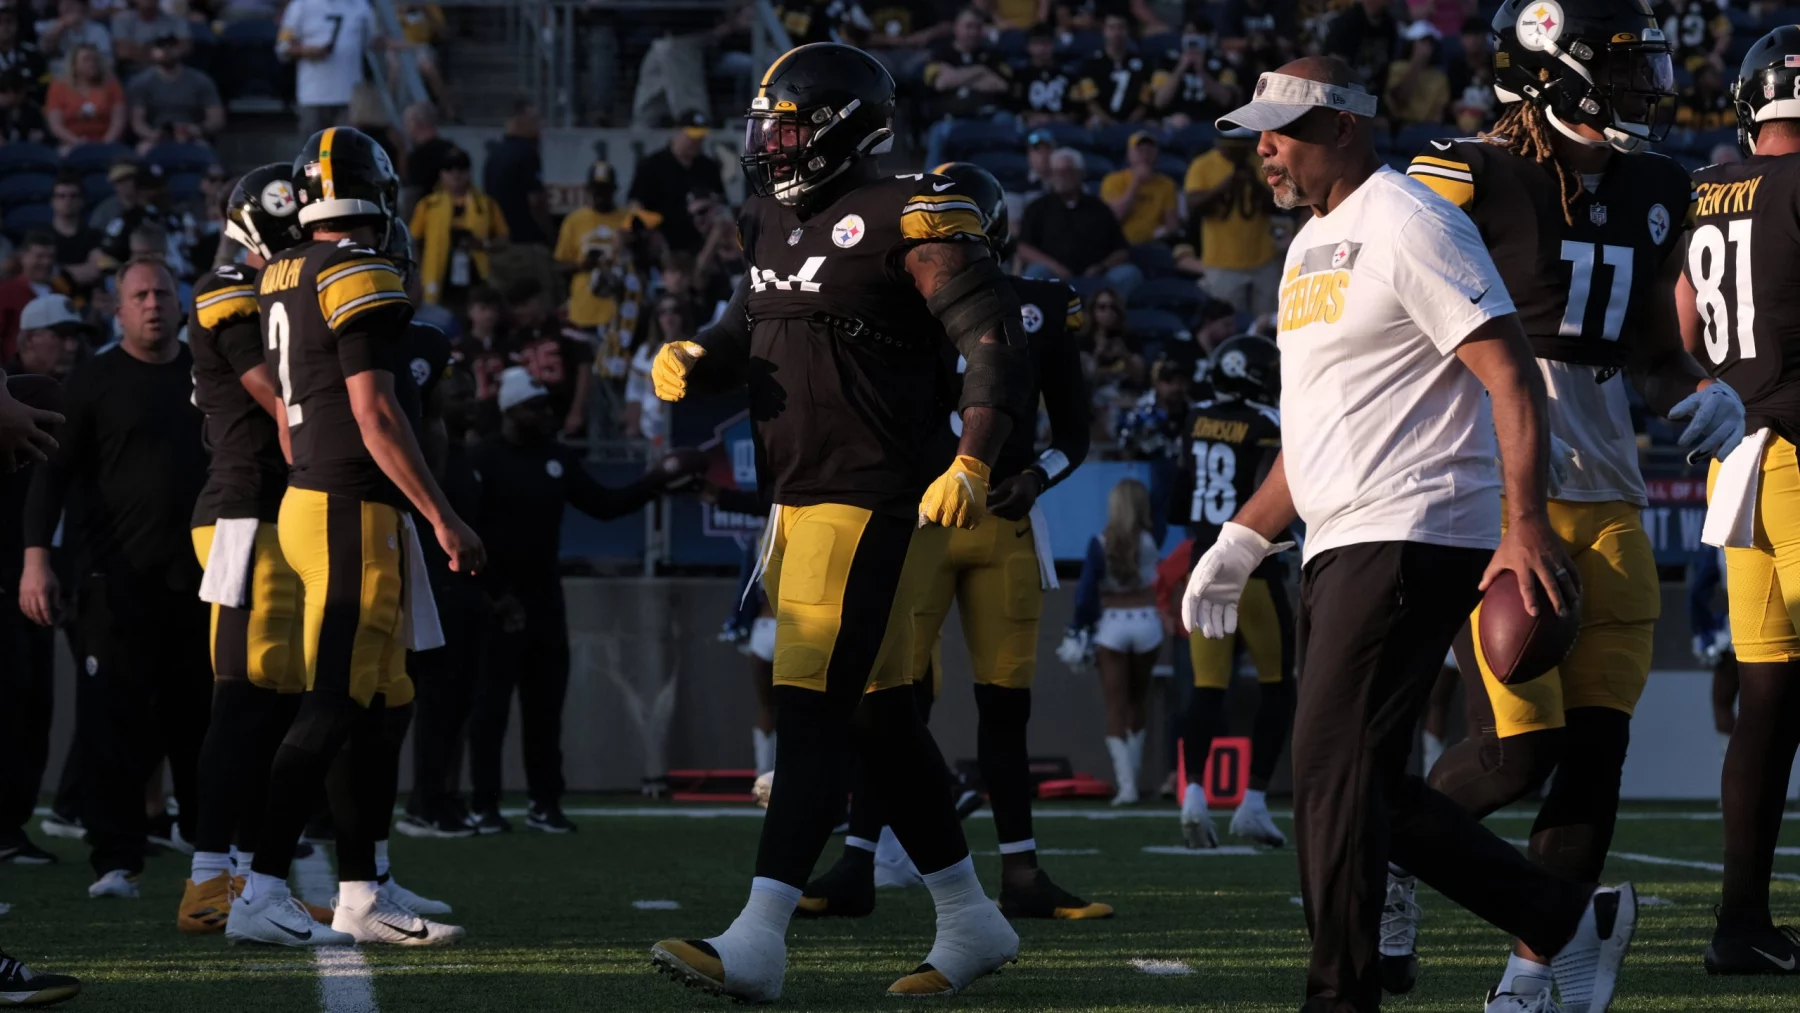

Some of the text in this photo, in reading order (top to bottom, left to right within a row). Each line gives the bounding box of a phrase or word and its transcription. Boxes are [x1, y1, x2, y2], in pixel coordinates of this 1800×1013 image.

[1109, 69, 1132, 112] 7
[1696, 175, 1763, 216] GENTRY
[1688, 218, 1757, 365] 81
[268, 301, 303, 427] 2
[1190, 439, 1238, 526] 18
[1213, 747, 1238, 797] 0
